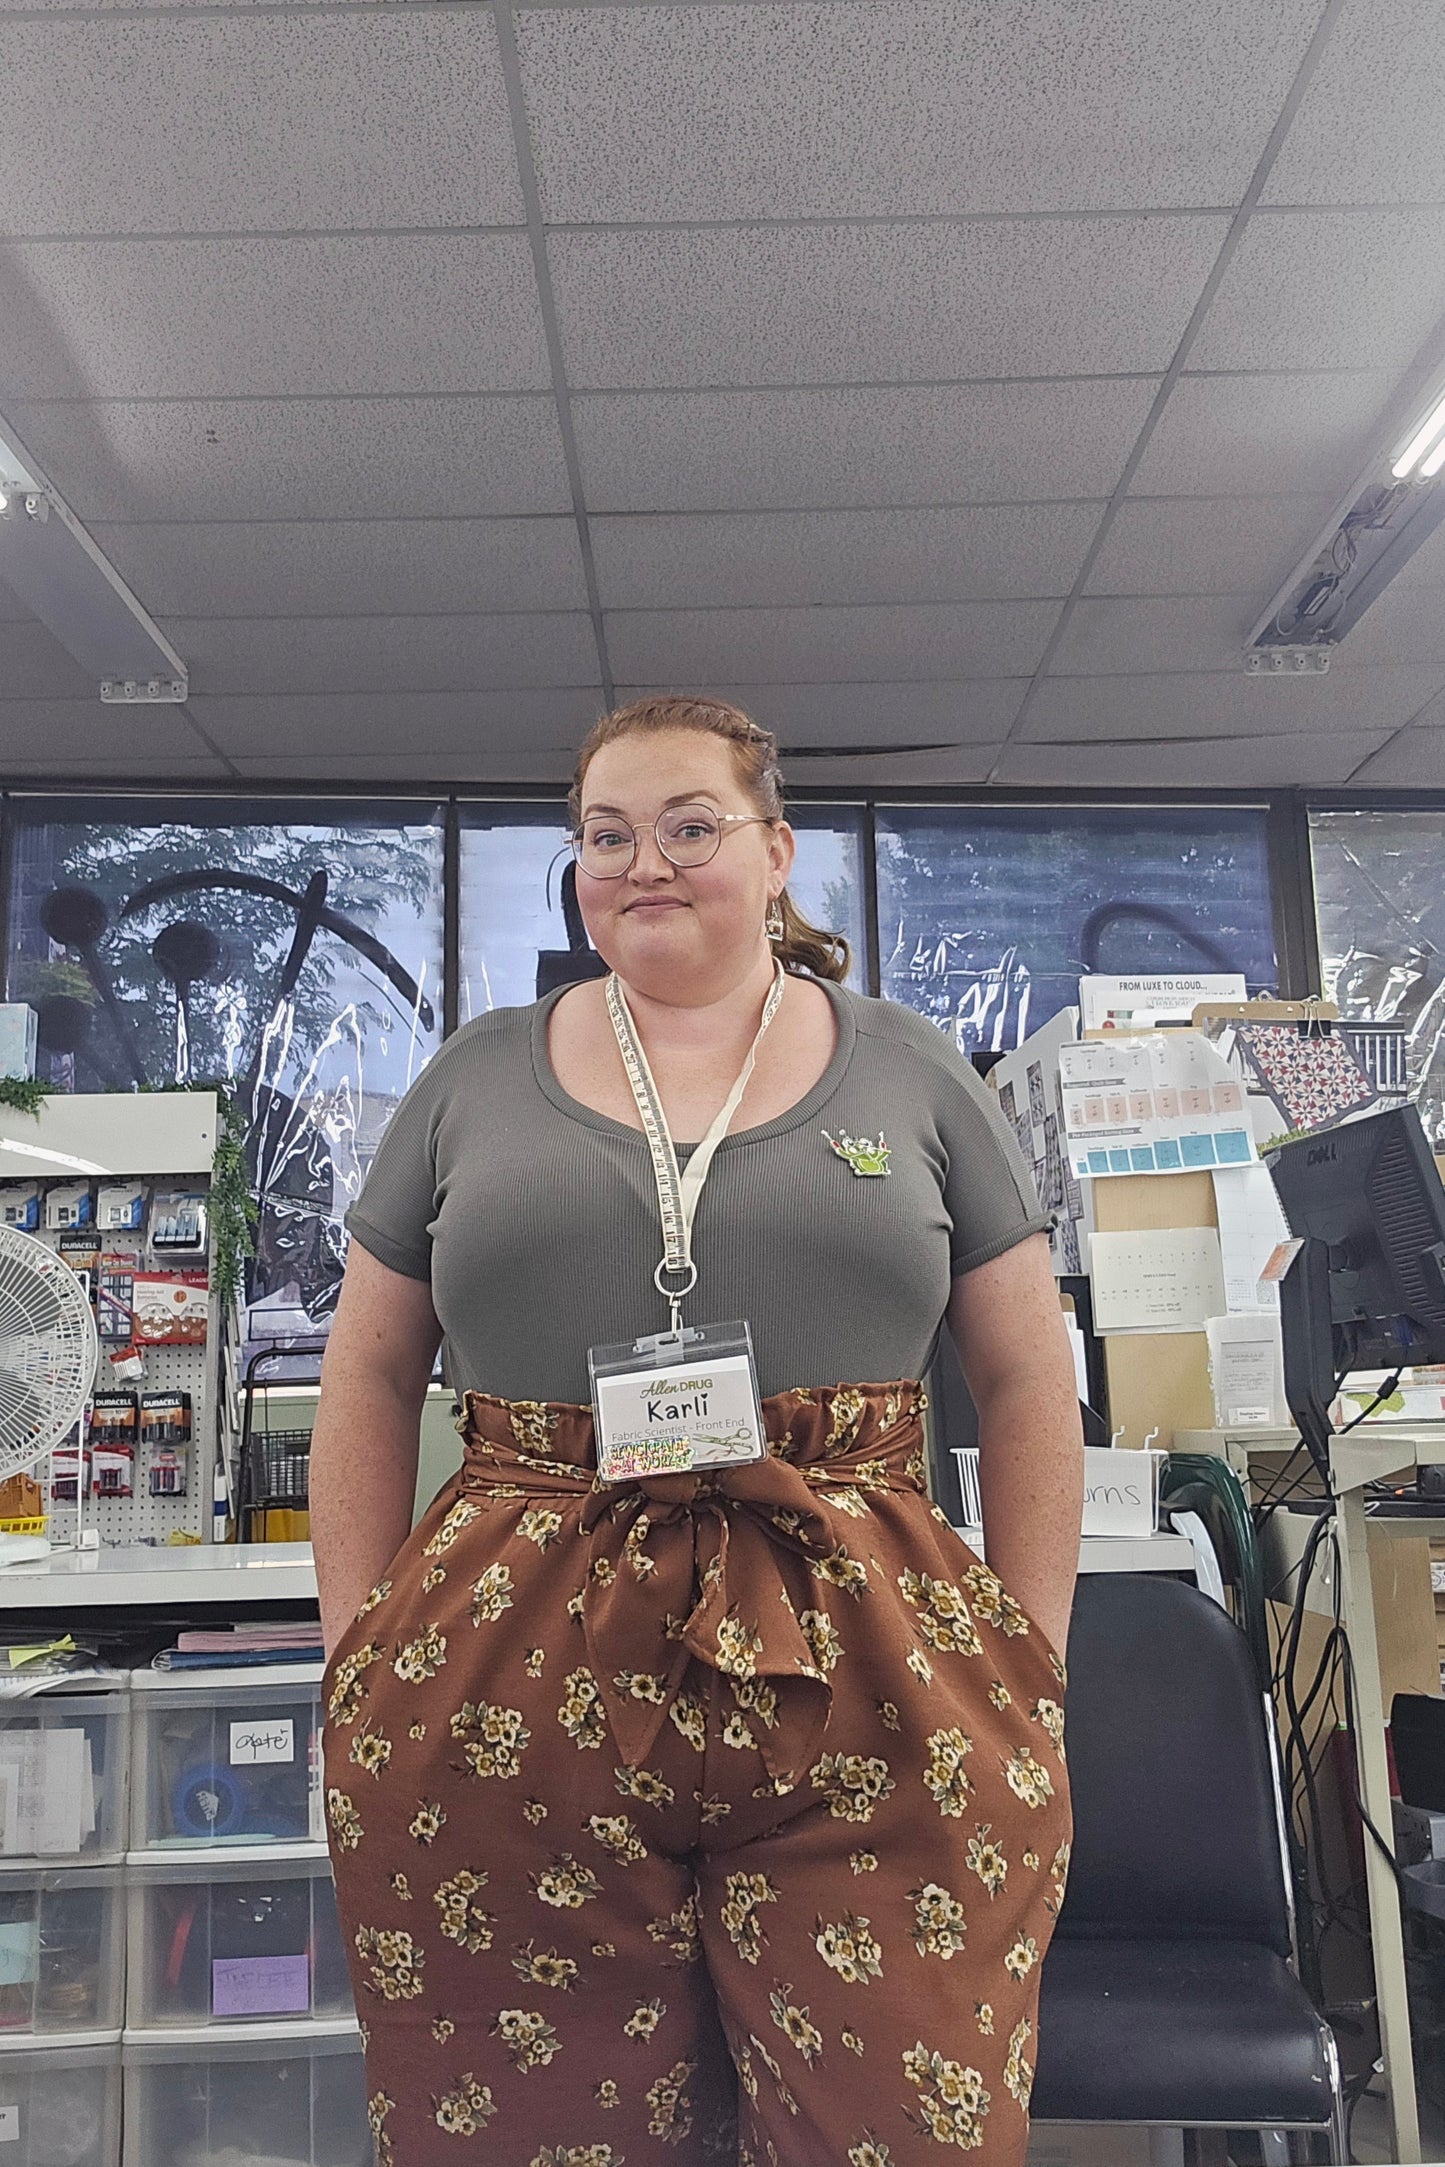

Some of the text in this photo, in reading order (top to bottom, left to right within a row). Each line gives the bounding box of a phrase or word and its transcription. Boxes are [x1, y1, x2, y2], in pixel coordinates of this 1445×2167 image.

[1119, 981, 1141, 991] FROM
[1143, 981, 1161, 991] LUXE
[1163, 981, 1174, 991] TO
[626, 1052, 636, 1064] 27
[1307, 1143, 1337, 1166] DELL
[661, 1192, 671, 1204] 15
[663, 1209, 674, 1224] 16
[666, 1230, 677, 1244] 17
[61, 1242, 98, 1250] DURACELL
[667, 1251, 679, 1266] 18
[640, 1379, 713, 1399] Allen DRUG
[95, 1398, 133, 1406] DURACELL
[142, 1398, 180, 1408] DURACELL
[648, 1393, 708, 1423] Karli
[612, 1429, 643, 1442] Fabric
[644, 1424, 687, 1438] Scientist
[695, 1419, 723, 1432] Front
[725, 1416, 745, 1428] End
